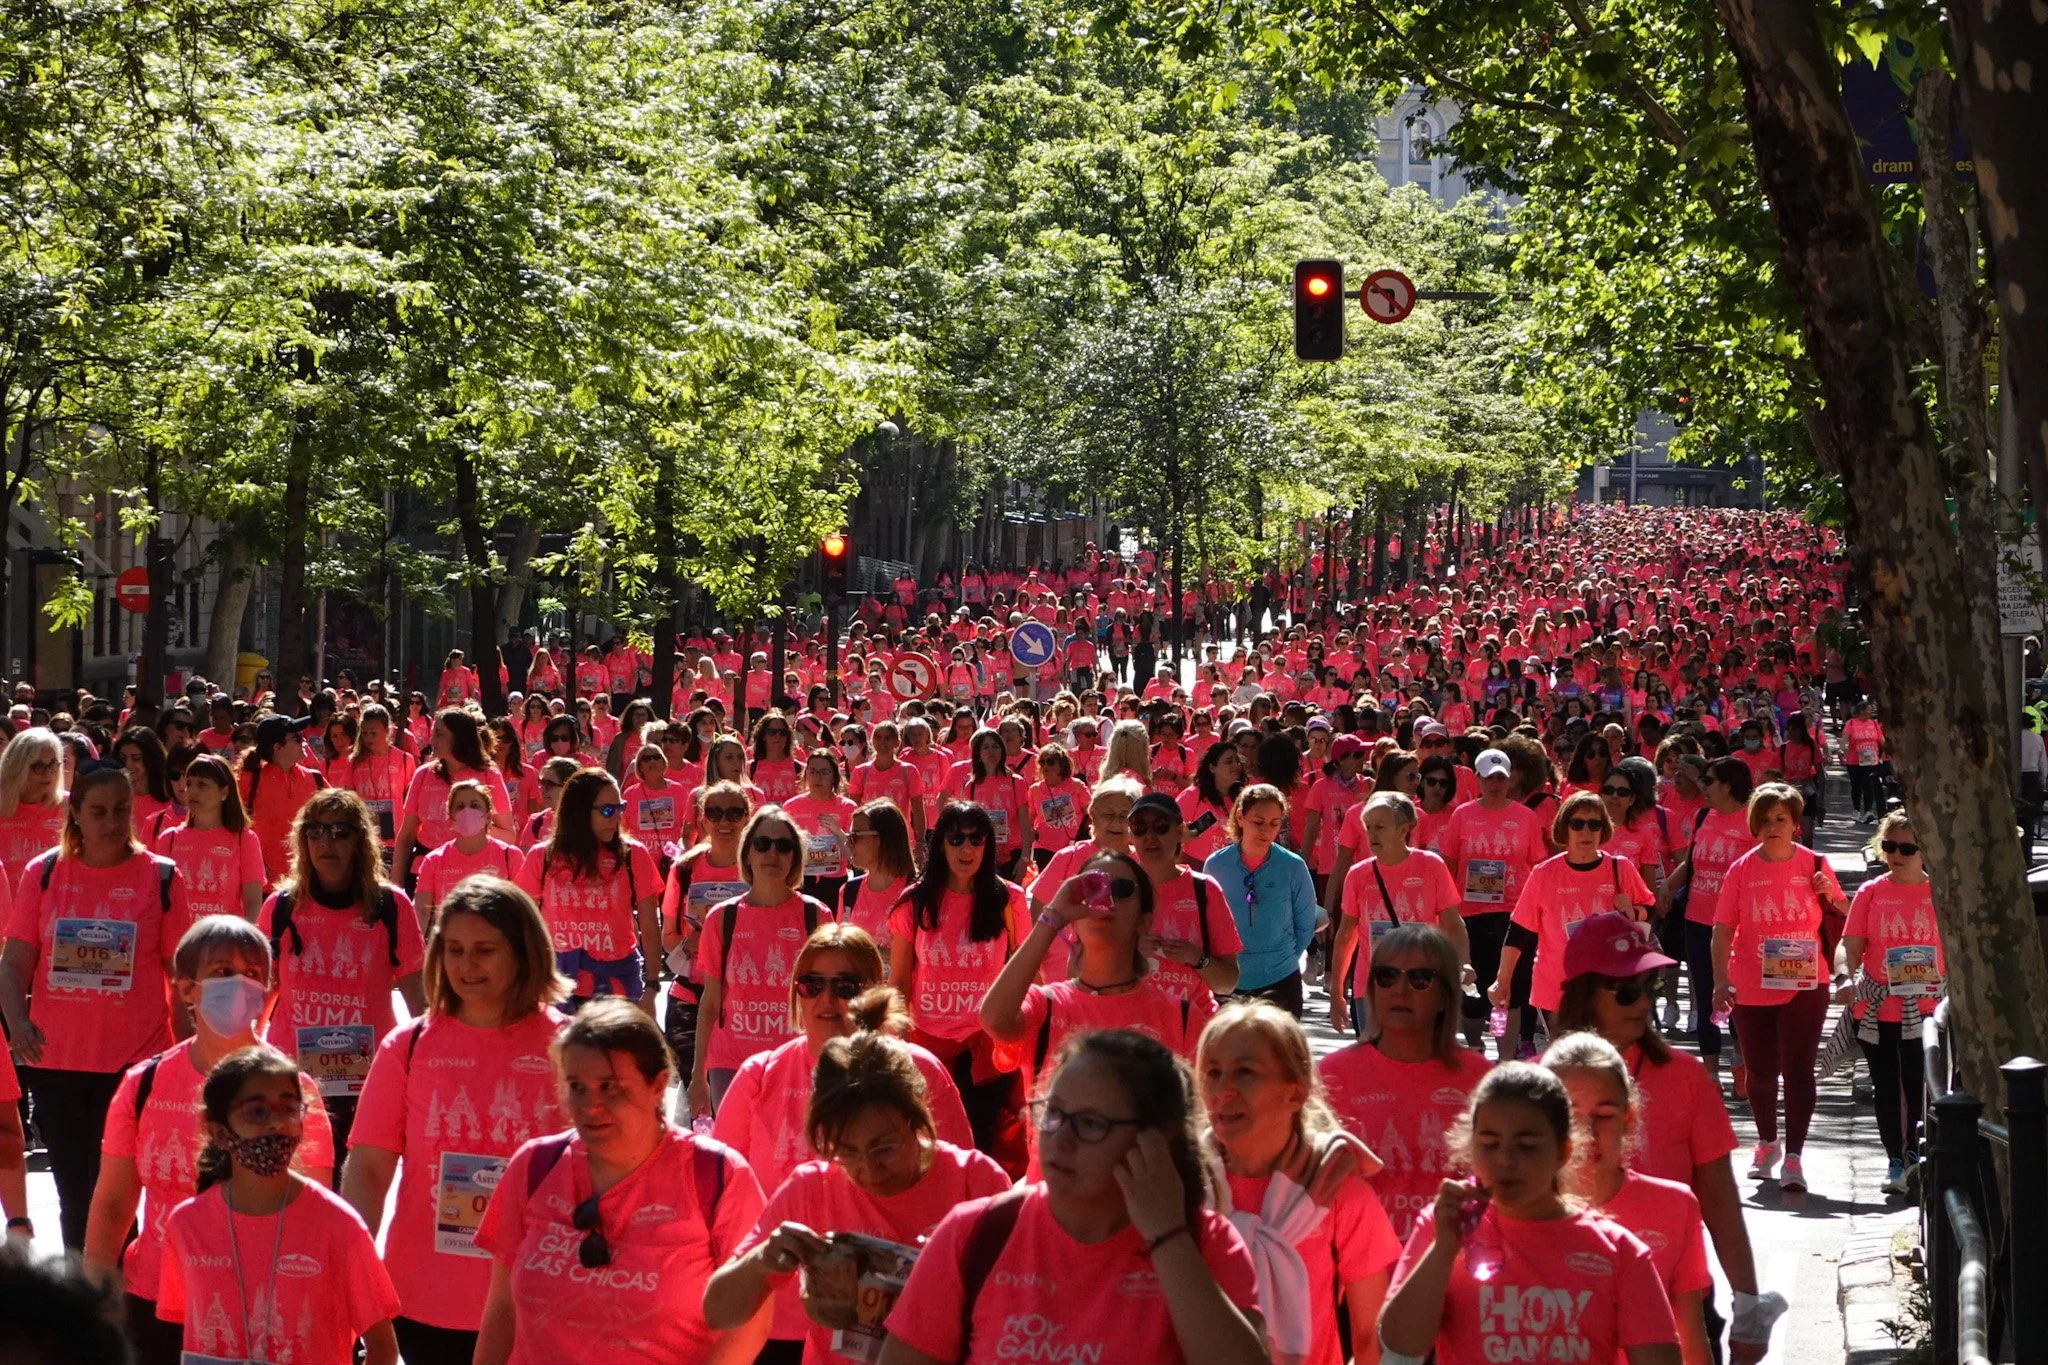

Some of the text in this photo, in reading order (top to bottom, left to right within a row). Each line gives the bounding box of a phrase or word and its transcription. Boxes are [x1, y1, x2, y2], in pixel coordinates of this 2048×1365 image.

[554, 921, 567, 931] TU
[554, 932, 614, 952] SUMA
[77, 945, 111, 960] 016
[1904, 964, 1927, 974] 016
[1151, 971, 1194, 984] ORSAL
[921, 981, 936, 992] TU
[291, 989, 368, 1009] TU DORSAL
[731, 999, 789, 1013] TU DORS
[291, 1003, 363, 1026] SUMA
[319, 1053, 352, 1066] 016
[428, 1057, 476, 1069] OYSHO
[444, 1239, 474, 1249] OYSH
[525, 1253, 659, 1293] LAS CHICAS
[1479, 1285, 1594, 1334] HOY
[1004, 1312, 1065, 1340] HOY
[996, 1334, 1103, 1364] GANAN
[1482, 1335, 1590, 1365] GANAN
